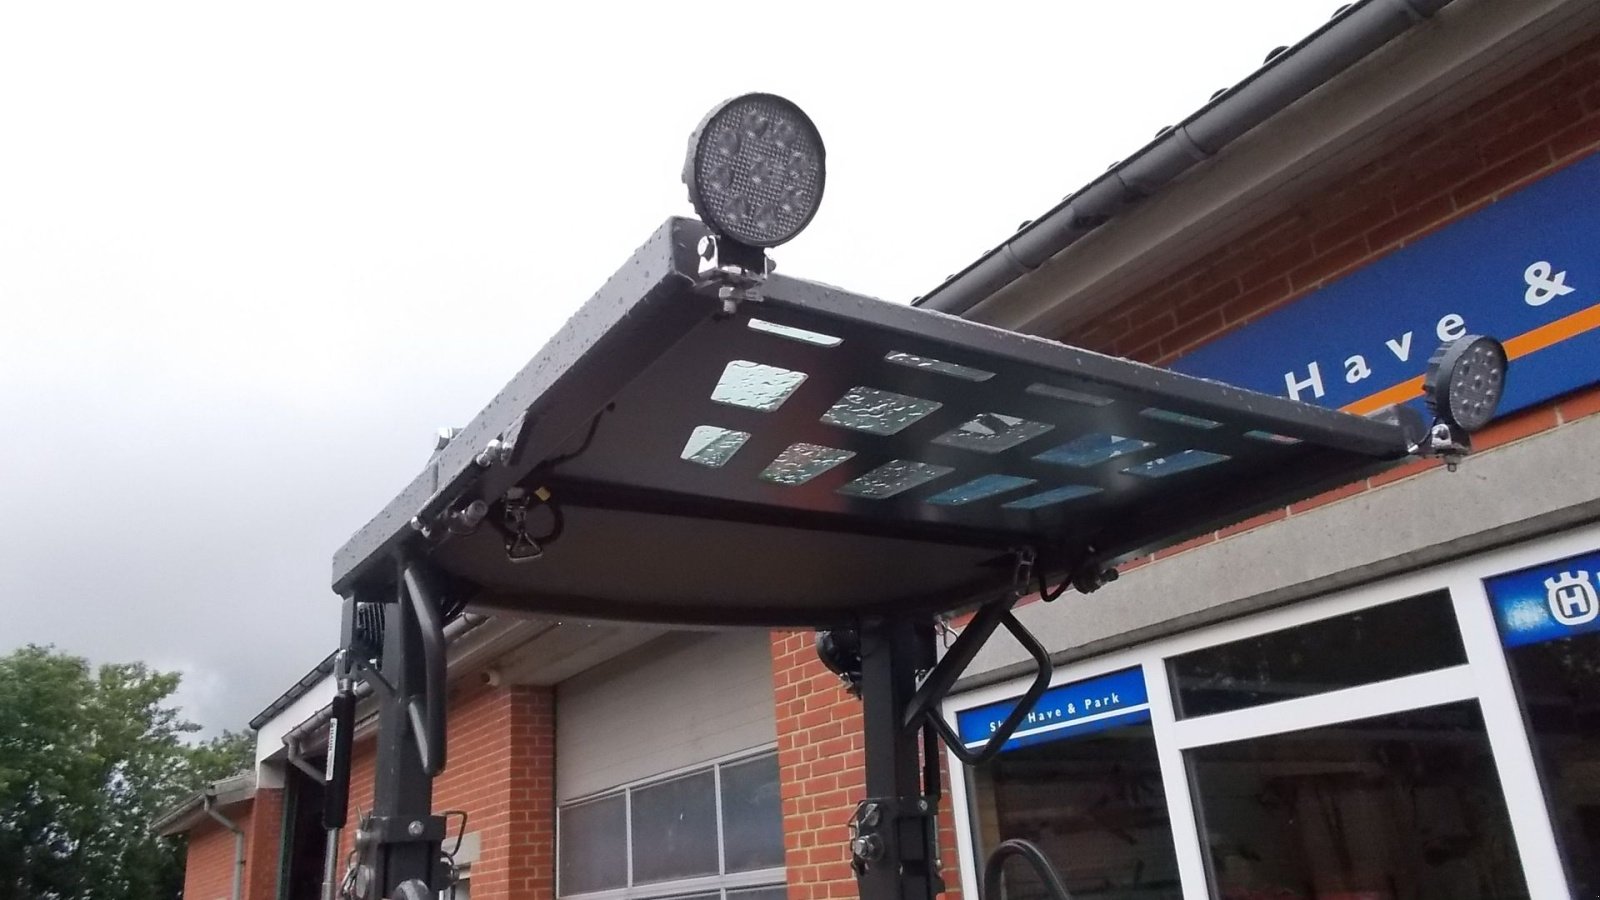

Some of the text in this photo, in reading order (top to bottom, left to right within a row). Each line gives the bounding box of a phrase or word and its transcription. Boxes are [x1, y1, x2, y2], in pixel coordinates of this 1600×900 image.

[1285, 261, 1576, 400] Have &
[1028, 693, 1120, 723] Have & Park
